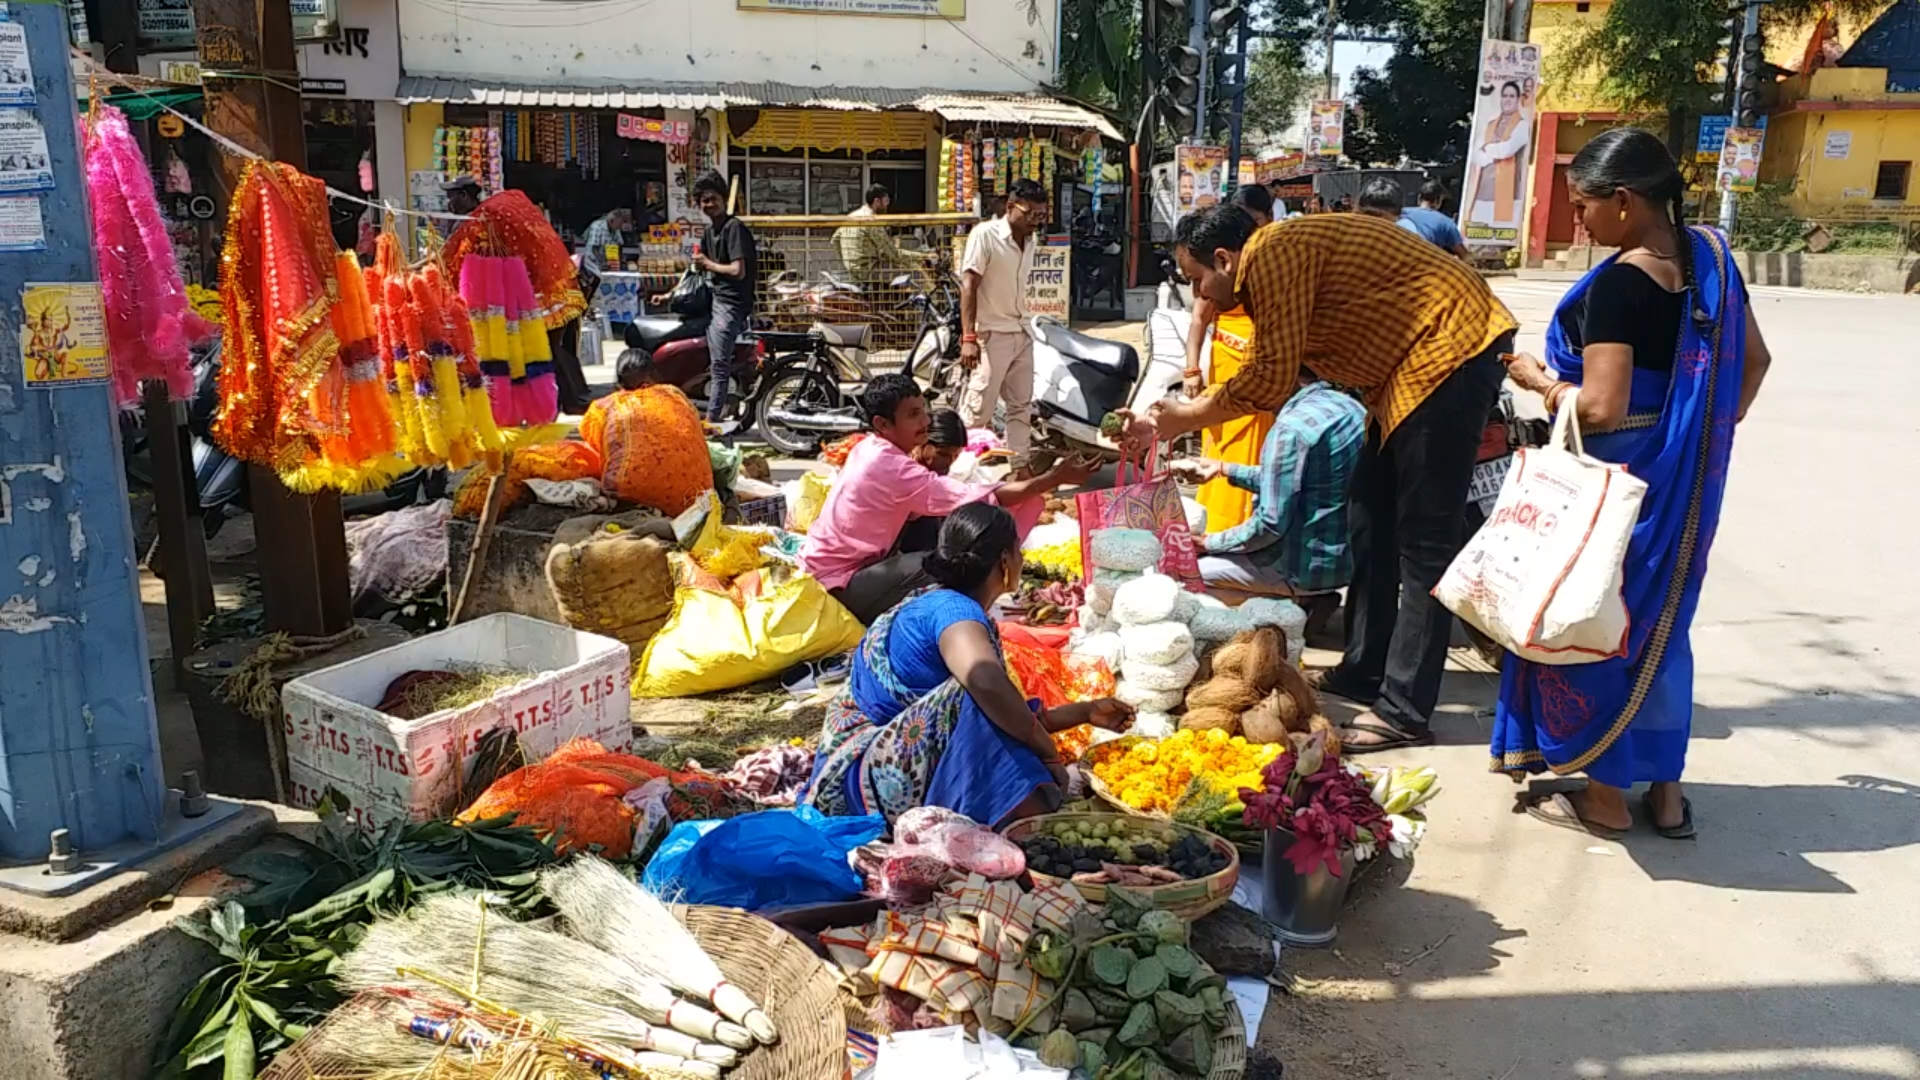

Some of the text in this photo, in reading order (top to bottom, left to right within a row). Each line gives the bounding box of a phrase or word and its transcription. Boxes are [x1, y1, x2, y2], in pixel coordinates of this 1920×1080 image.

[1472, 458, 1512, 481] G04M
[515, 700, 551, 734] T.T.S
[320, 725, 350, 756] T.T.S
[374, 744, 409, 776] T.T.S
